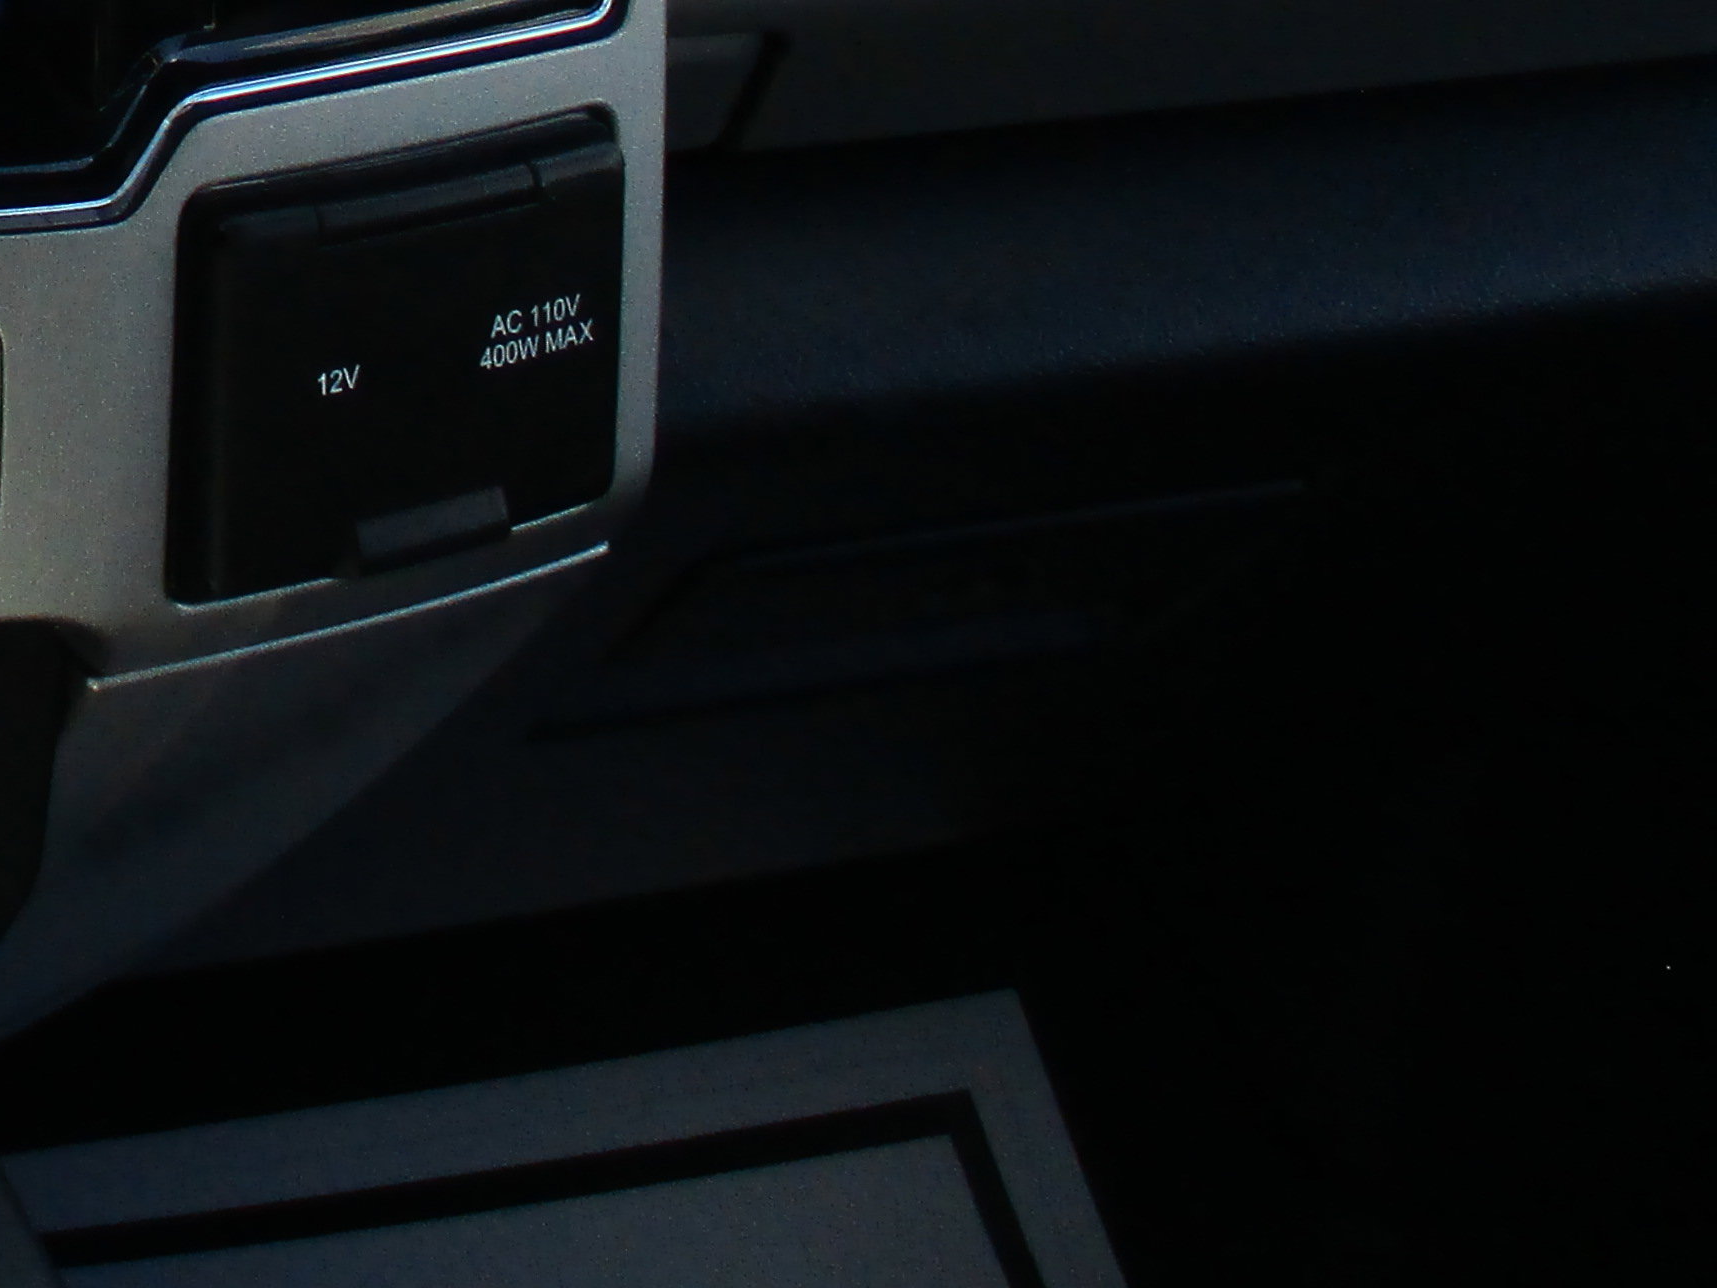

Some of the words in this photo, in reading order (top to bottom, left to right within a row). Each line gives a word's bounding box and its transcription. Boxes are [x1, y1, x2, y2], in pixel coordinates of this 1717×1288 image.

[491, 309, 522, 338] AC
[531, 294, 581, 327] 110V
[480, 334, 540, 370] 400W
[545, 321, 593, 352] MAX
[318, 365, 360, 395] 12V
